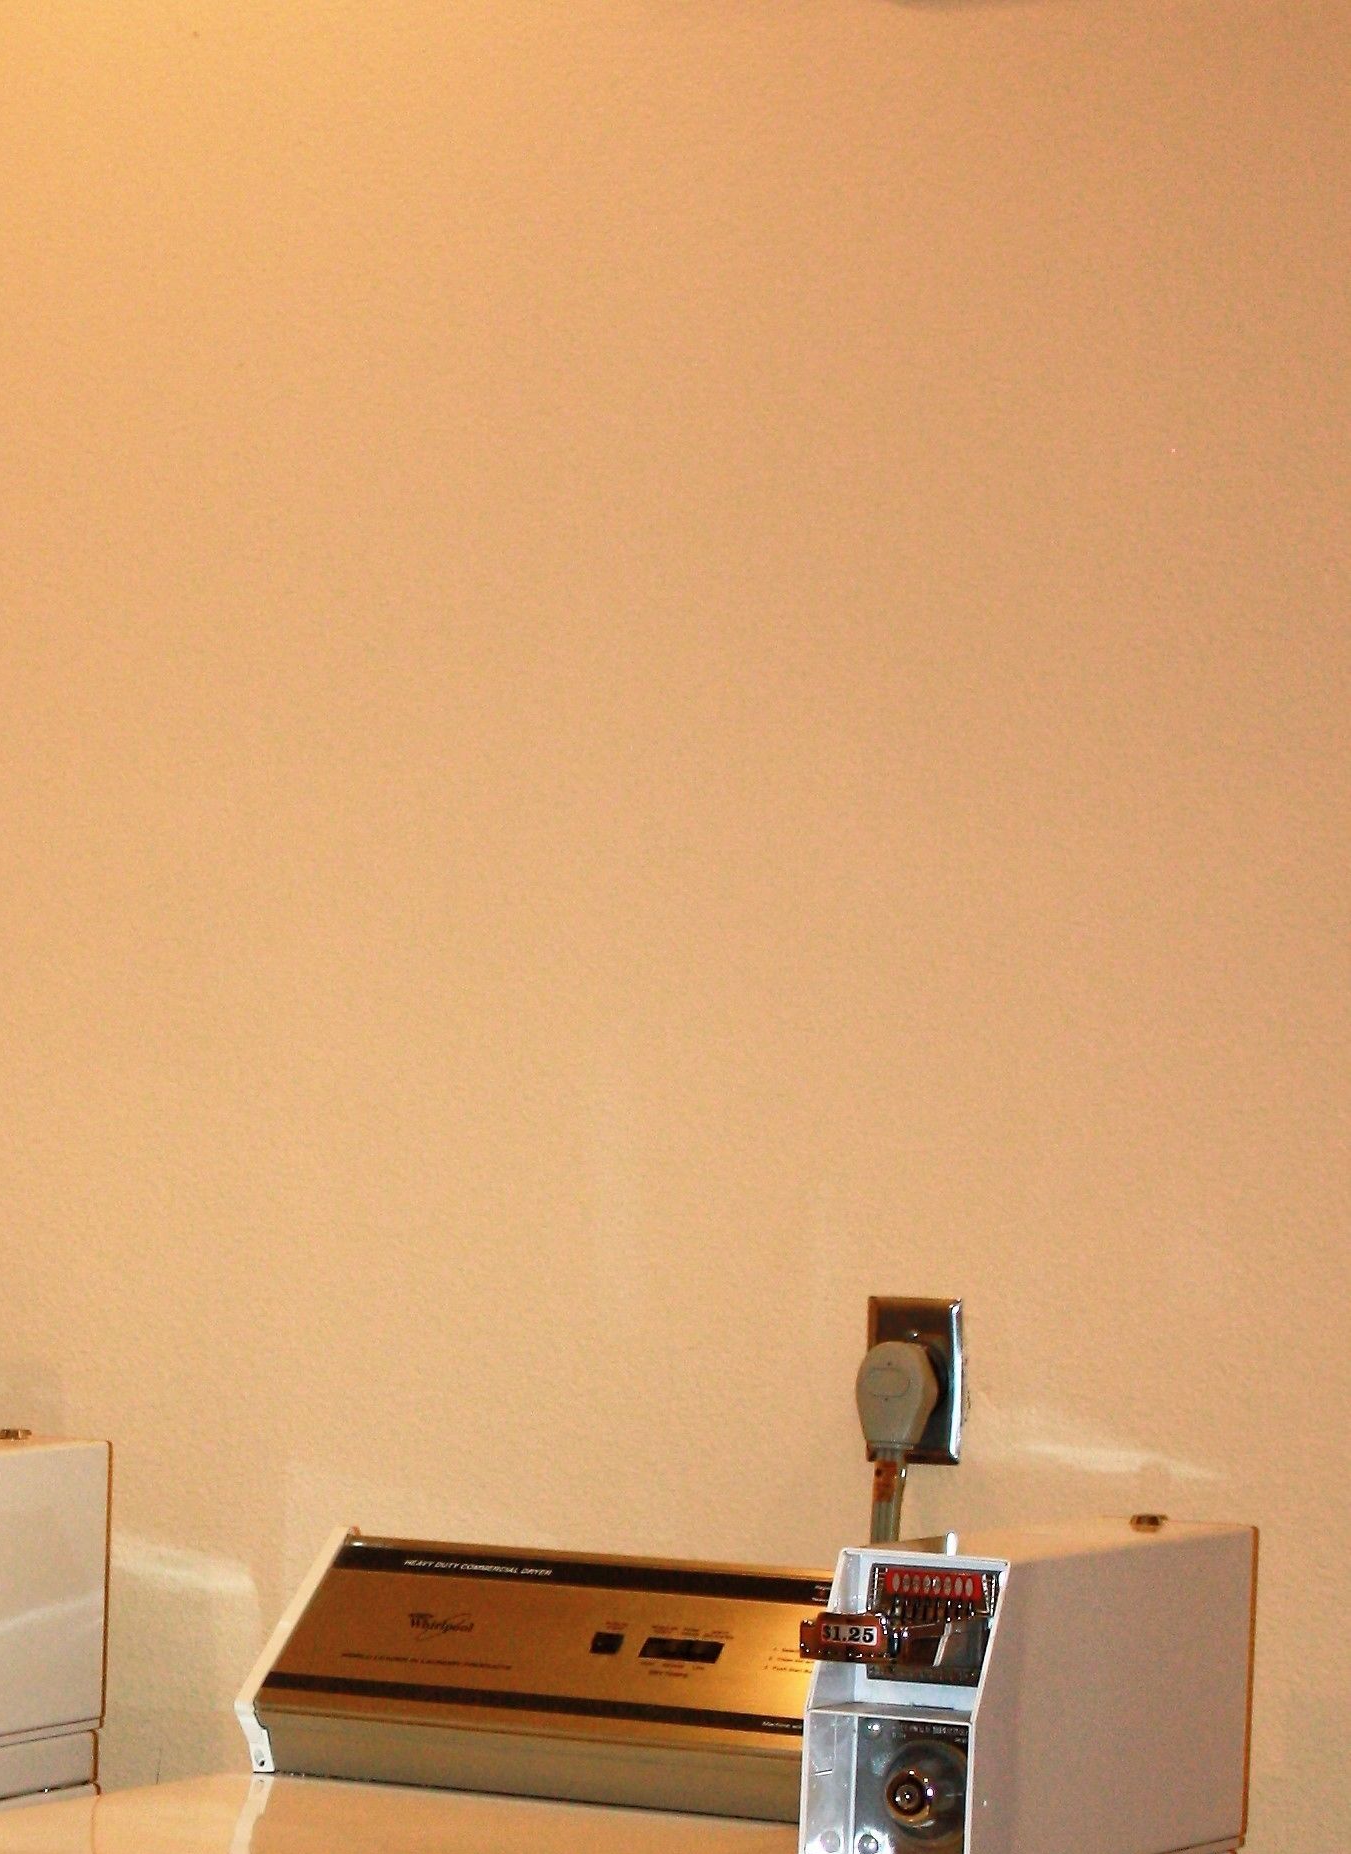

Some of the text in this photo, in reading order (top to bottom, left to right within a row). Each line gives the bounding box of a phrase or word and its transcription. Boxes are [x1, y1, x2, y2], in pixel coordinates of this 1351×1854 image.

[404, 1559, 553, 1576] HEAVY DUTY COMMERCIAL DRYER
[408, 1613, 474, 1634] Whirlpool
[822, 1624, 874, 1643] $1.25
